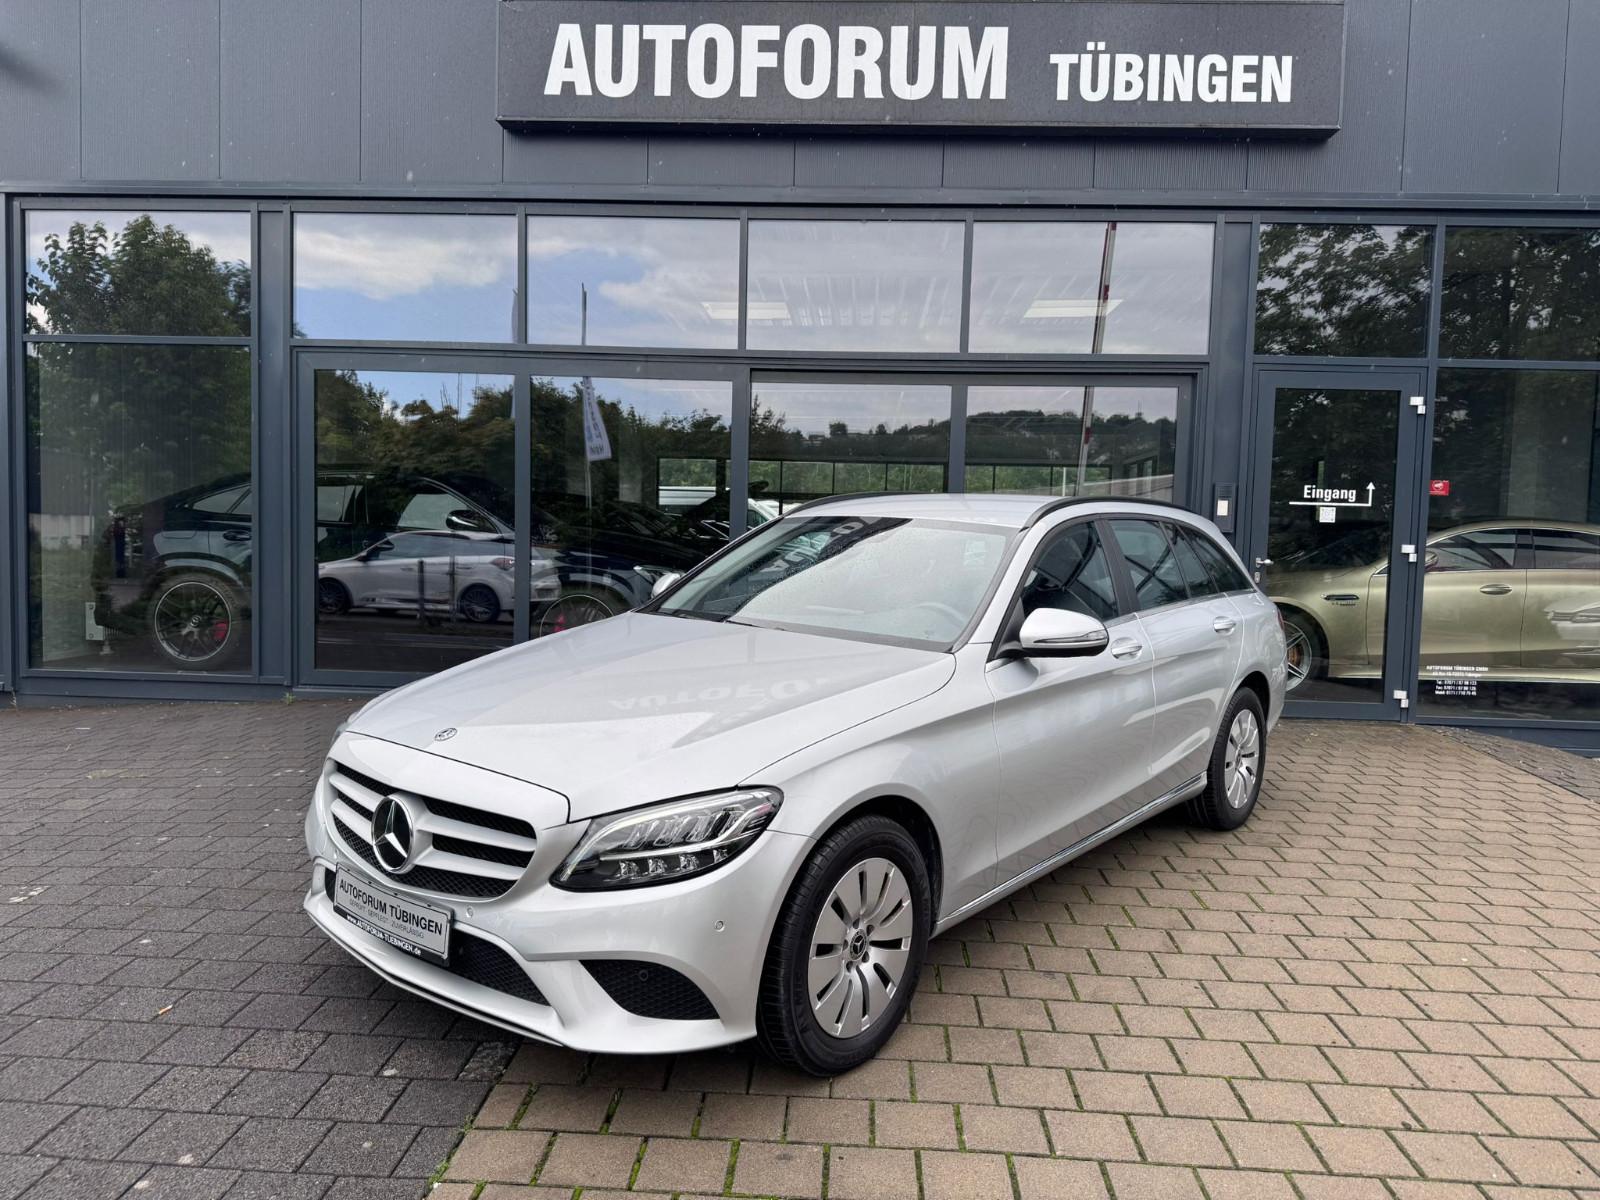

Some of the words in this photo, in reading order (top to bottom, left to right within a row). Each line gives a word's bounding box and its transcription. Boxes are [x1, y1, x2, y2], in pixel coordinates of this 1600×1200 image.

[543, 22, 1009, 100] AUTOFORUM
[1049, 41, 1293, 103] TÜBINGEN
[1303, 484, 1357, 502] Eingang
[339, 879, 387, 914] AUTOFORUM
[389, 901, 443, 935] TÜBINGEN
